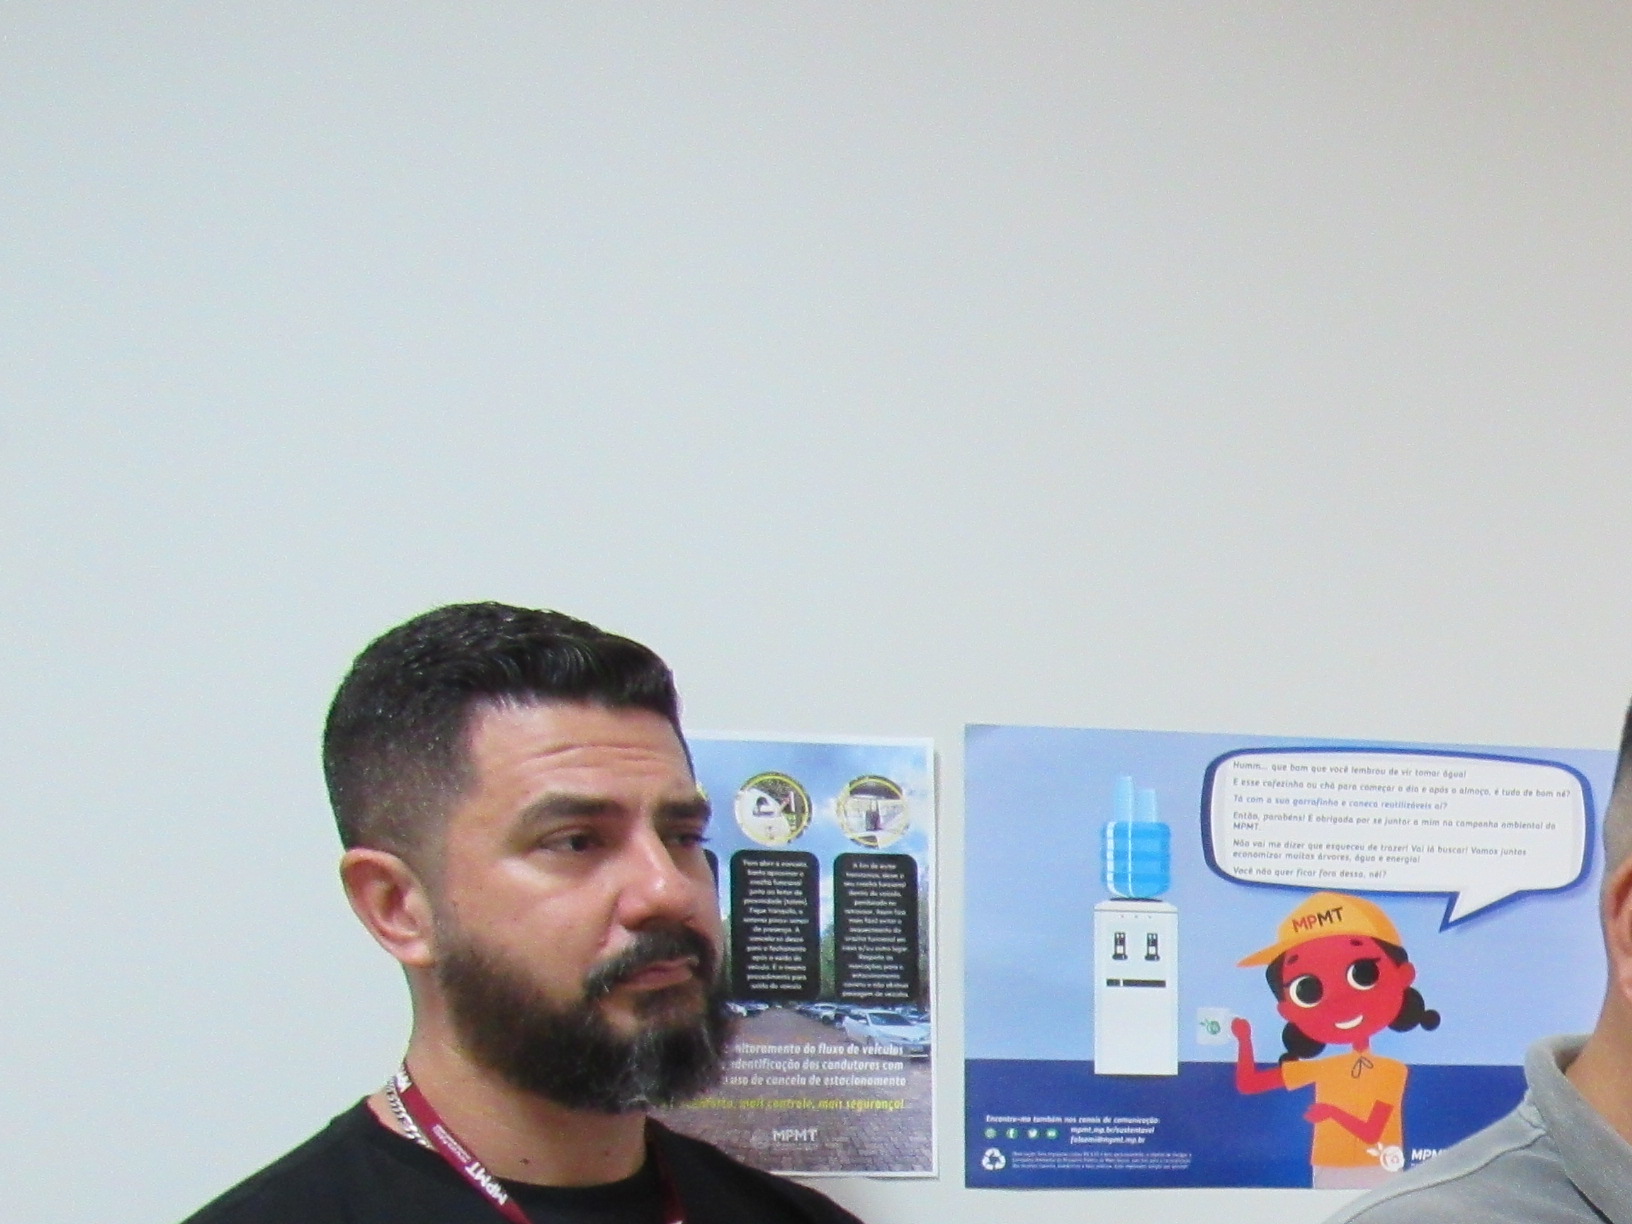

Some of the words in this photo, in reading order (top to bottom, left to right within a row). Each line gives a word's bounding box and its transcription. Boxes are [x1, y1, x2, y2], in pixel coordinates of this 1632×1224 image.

[1233, 761, 1268, 771] Humm...
[1272, 764, 1287, 772] que
[1290, 762, 1308, 772] bom
[1330, 765, 1348, 773] você
[1352, 764, 1386, 775] lembrou
[1389, 767, 1398, 775] de
[1443, 770, 1466, 779] água!
[1263, 780, 1303, 789] cafezinho
[1320, 781, 1335, 790] chá
[1338, 783, 1357, 792] para
[1360, 784, 1394, 793] começar
[1429, 786, 1448, 795] após
[1459, 786, 1491, 797] almoço,
[1494, 788, 1499, 796] é
[1502, 789, 1520, 797] tudo
[1523, 789, 1533, 797] de
[1536, 790, 1553, 798] bom
[1556, 790, 1571, 798] né?
[1233, 794, 1243, 802] Tá
[1246, 795, 1263, 803] com
[1275, 797, 1289, 805] sua
[1292, 796, 1338, 807] garrafinha
[1349, 800, 1378, 808] caneca
[1381, 800, 1432, 810] reutilizáveis
[1233, 812, 1260, 821] Então,
[1263, 814, 1305, 822] parabéns!
[1356, 817, 1369, 825] por
[1384, 817, 1410, 827] juntar
[1422, 818, 1440, 826] mim
[1443, 819, 1453, 827] na
[1456, 821, 1498, 829] campanha
[1501, 821, 1543, 830] ambiental
[1233, 839, 1249, 848] Não
[1253, 840, 1265, 848] vai
[1284, 841, 1305, 849] dizer
[1326, 843, 1365, 853] esqueceu
[1381, 845, 1409, 854] trazer!
[1412, 845, 1424, 853] Vai
[1427, 845, 1435, 853] lá
[1438, 846, 1468, 854] buscar!
[1471, 847, 1498, 855] Vamos
[1233, 851, 1282, 860] economizar
[1285, 852, 1315, 861] muitas
[1318, 852, 1352, 862] árvores,
[1355, 854, 1375, 863] água
[1386, 856, 1420, 864] energia!
[1233, 867, 1253, 875] Você
[1256, 868, 1272, 876] não
[1275, 868, 1294, 877] quer
[1296, 868, 1316, 877] ficar
[1319, 869, 1336, 879] fora
[1340, 869, 1366, 878] dessa,
[1292, 907, 1343, 933] MPMT
[724, 1043, 801, 1055] nitoramento
[803, 1043, 816, 1055] do
[819, 1043, 844, 1055] fluxo
[847, 1043, 859, 1055] de
[862, 1044, 904, 1055] veículos
[802, 1059, 819, 1070] dos
[822, 1059, 879, 1071] condutores
[882, 1061, 904, 1070] com
[750, 1074, 763, 1086] de
[766, 1075, 806, 1087] cancela
[808, 1075, 821, 1087] de
[824, 1076, 906, 1087] estacionamento
[818, 1098, 842, 1109] mais
[846, 1098, 905, 1111] segurança!
[772, 1127, 817, 1142] MPMT
[1411, 1149, 1442, 1161] MPM
